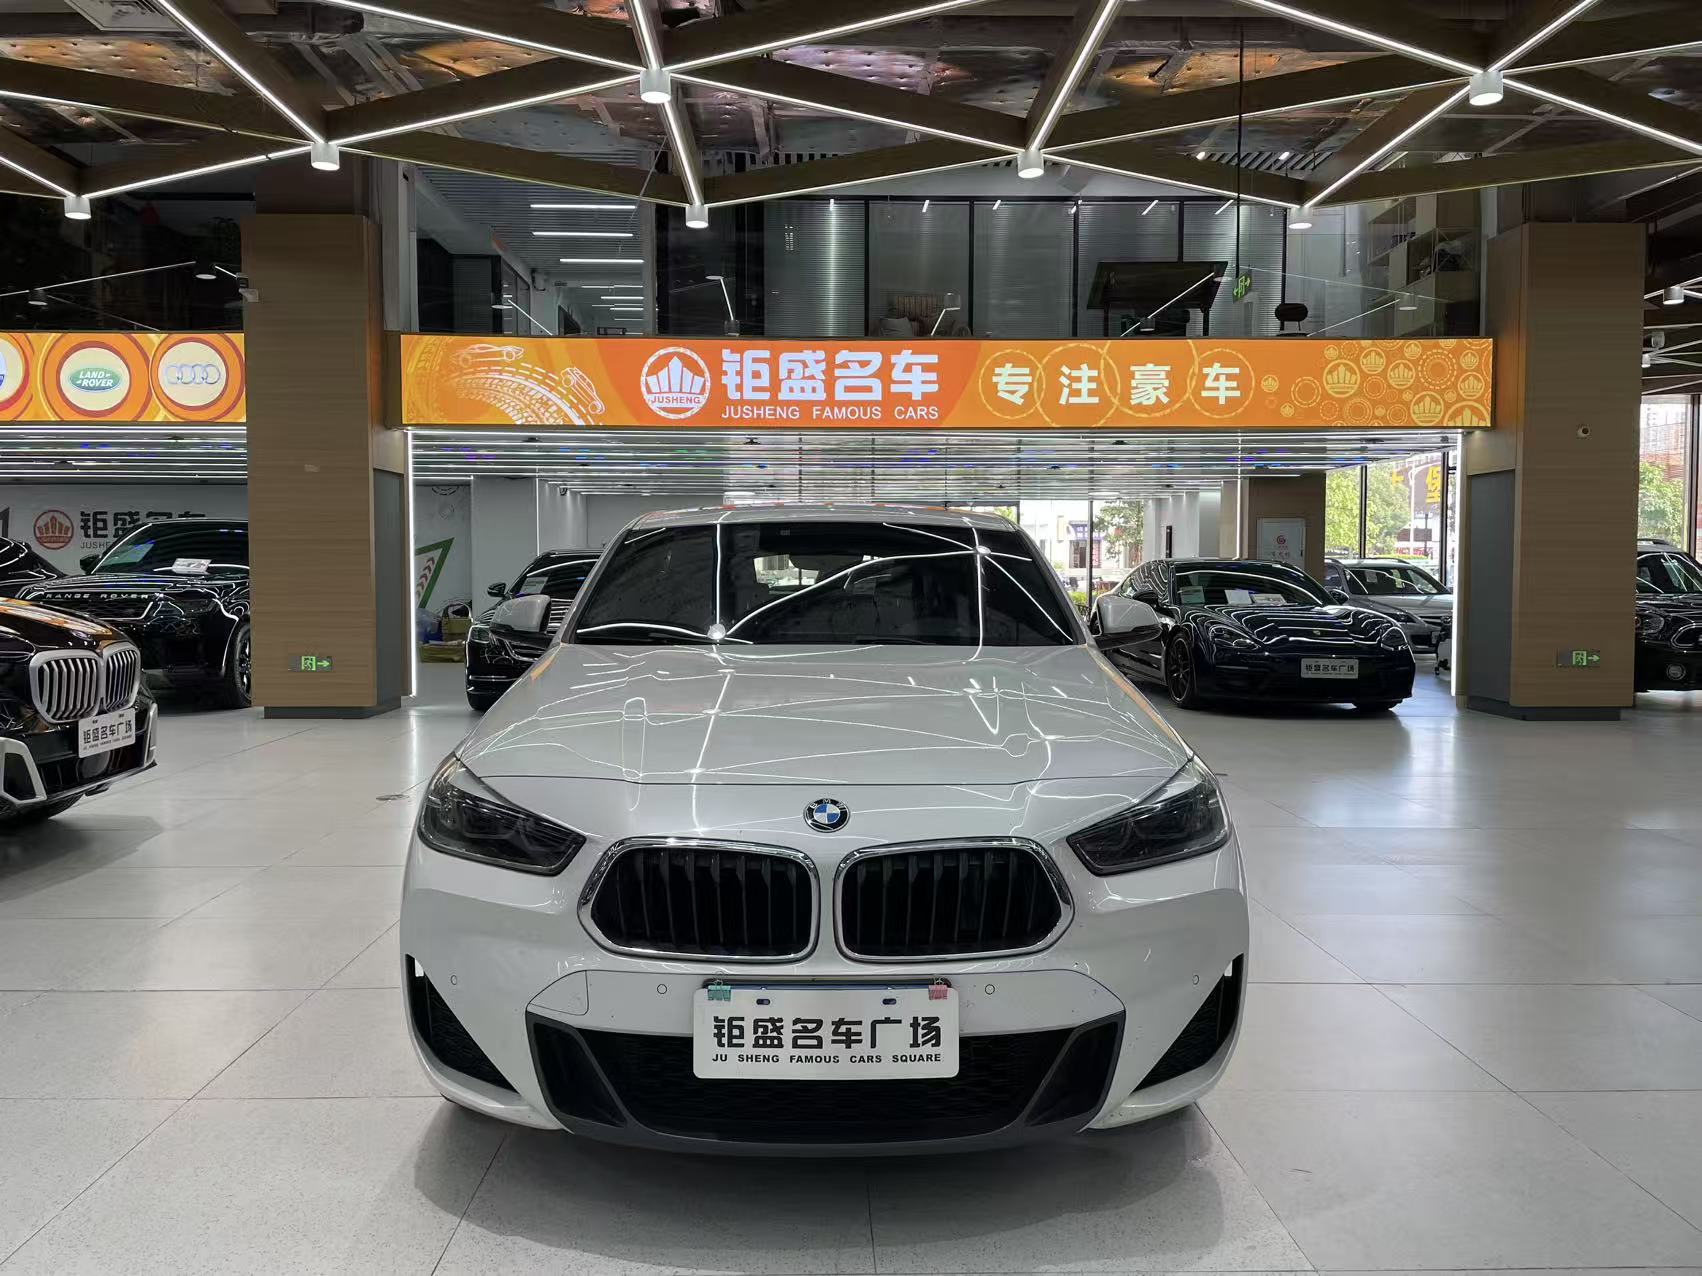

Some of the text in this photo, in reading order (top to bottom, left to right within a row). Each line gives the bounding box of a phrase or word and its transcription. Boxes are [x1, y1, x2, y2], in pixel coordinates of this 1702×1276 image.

[721, 348, 939, 401] 钜盛名车
[650, 395, 701, 404] JUSHENG
[721, 405, 939, 419] JUSHENG FAMOUS CARS
[712, 1015, 942, 1050] 钜盛名车广场
[711, 1052, 942, 1065] JU SHENG FAMOUS CARS SQUARE
